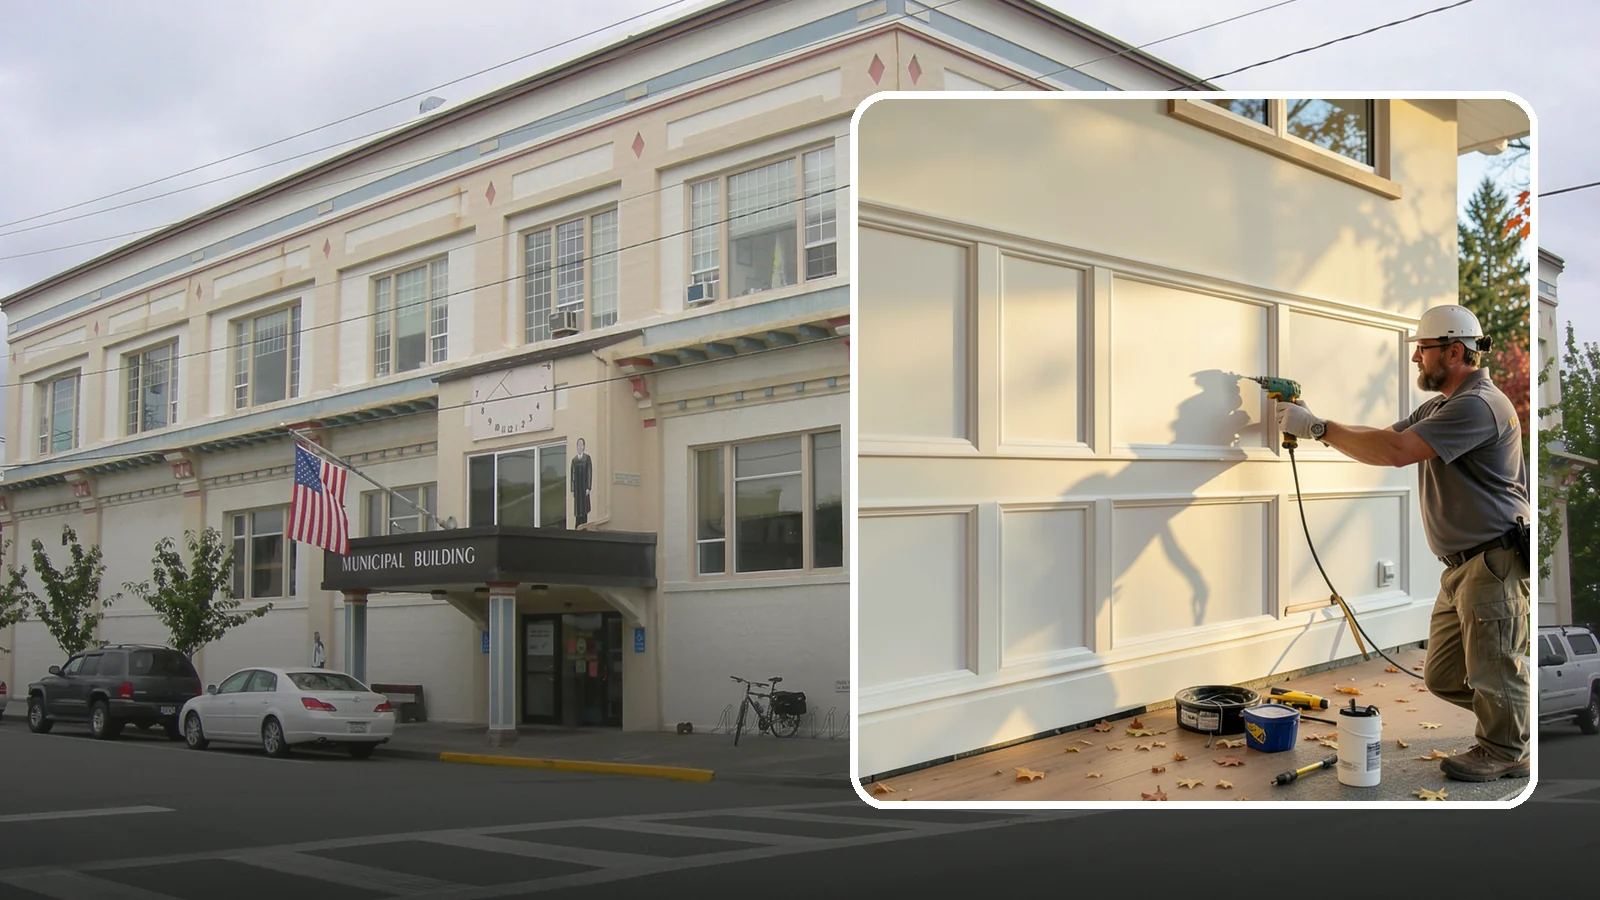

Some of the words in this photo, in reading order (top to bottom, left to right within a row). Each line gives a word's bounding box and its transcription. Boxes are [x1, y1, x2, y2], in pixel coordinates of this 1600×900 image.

[547, 362, 551, 370] 6
[476, 390, 479, 398] 7
[536, 402, 540, 410] 4
[480, 407, 485, 415] 8
[488, 418, 492, 426] 9
[529, 414, 533, 422] 3
[508, 425, 513, 433] 12
[342, 552, 405, 572] MUNICIPAL
[414, 546, 475, 567] BUILDING
